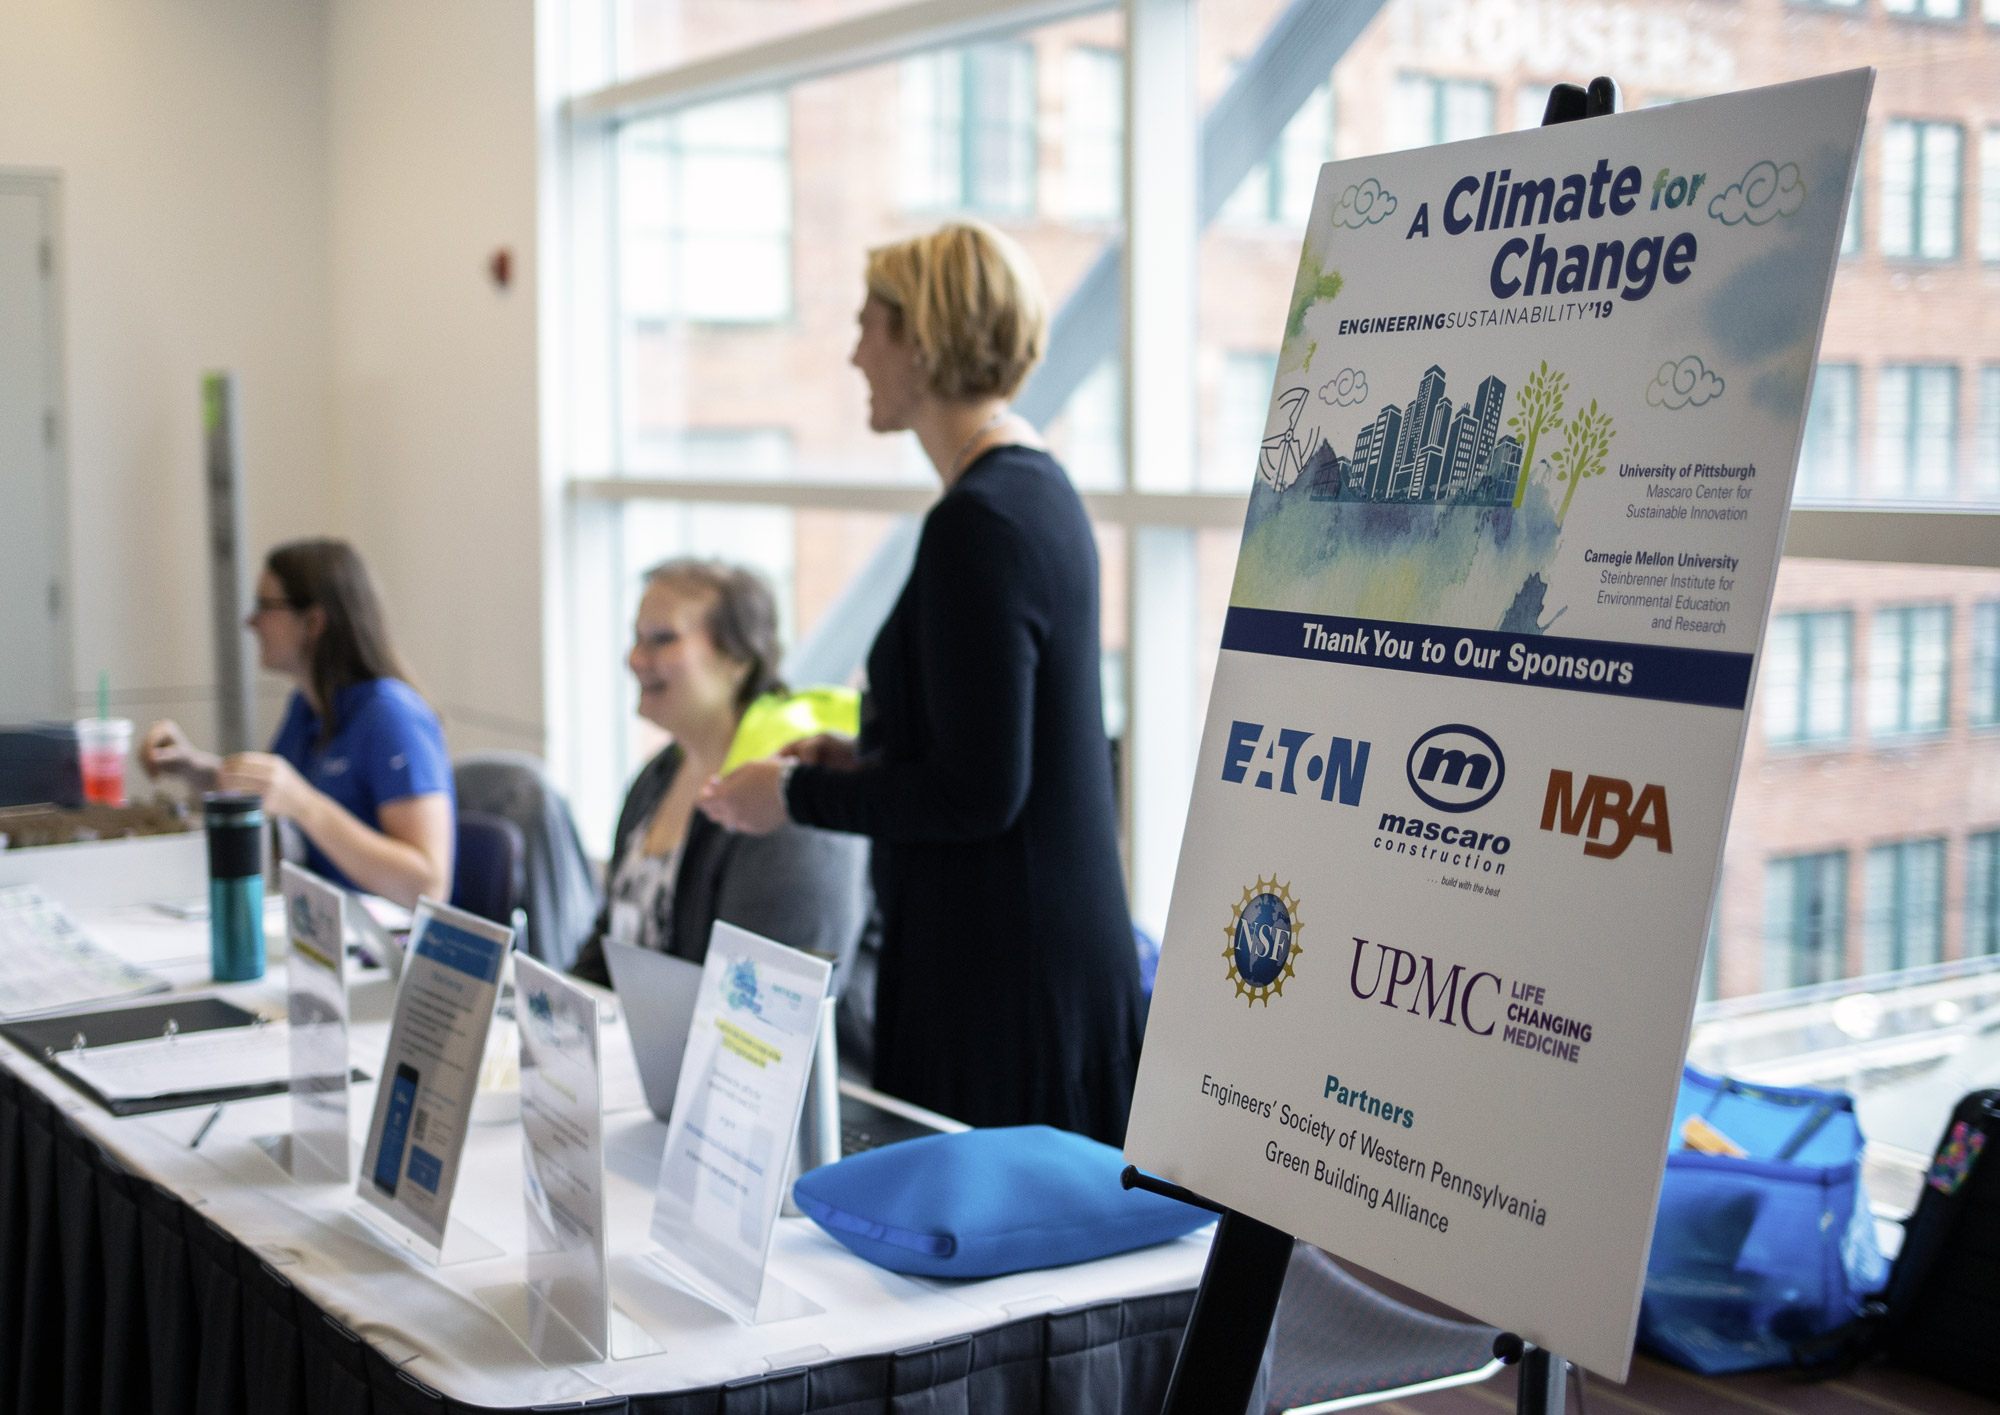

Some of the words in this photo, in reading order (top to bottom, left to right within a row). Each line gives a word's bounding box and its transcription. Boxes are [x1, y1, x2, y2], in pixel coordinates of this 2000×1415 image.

[1406, 202, 1429, 240] A
[1443, 158, 1642, 236] Climate
[1650, 167, 1706, 212] for
[1491, 231, 1698, 301] Change
[1619, 464, 1677, 480] University
[1679, 464, 1692, 478] of
[1694, 464, 1756, 481] Pittsburgh
[1646, 484, 1692, 499] Mascaro
[1696, 485, 1734, 499] Center
[1736, 486, 1752, 499] for
[1626, 504, 1687, 519] Sustainable
[1690, 505, 1748, 520] Innovation
[1584, 549, 1632, 566] Carnegie
[1635, 551, 1674, 566] Mellon
[1677, 553, 1739, 572] University
[1600, 570, 1668, 587] Steinbrenner
[1670, 574, 1715, 590] Institute
[1719, 576, 1735, 590] for
[1597, 590, 1673, 608] Environmental
[1675, 595, 1730, 612] Education
[1651, 616, 1672, 630] and
[1674, 616, 1726, 634] Research
[1301, 622, 1369, 657] Thank
[1372, 627, 1413, 661] You
[1421, 637, 1446, 664] to
[1453, 637, 1501, 670] Our
[1507, 644, 1634, 685] Sponsors
[1221, 720, 1371, 807] EATON
[1539, 768, 1673, 860] MBA
[1379, 813, 1511, 856] mascaro
[1373, 836, 1505, 875] construction
[1441, 876, 1458, 888] build
[1458, 881, 1472, 891] with
[1473, 883, 1484, 894] the
[1485, 885, 1501, 897] best
[1235, 917, 1291, 964] NSF
[1350, 937, 1503, 1036] UPMC
[1510, 980, 1546, 1006] LIFE
[1507, 1003, 1593, 1043] CHANGING
[1503, 1024, 1580, 1064] MEDICINE
[1323, 1074, 1415, 1129] Partners
[1279, 1104, 1335, 1146] Society
[1339, 1131, 1357, 1151] of
[1360, 1133, 1426, 1179] Western
[1430, 1161, 1548, 1227] Pennsylvania
[1265, 1140, 1310, 1176] Green
[1314, 1159, 1379, 1208] Building
[1382, 1188, 1449, 1234] Alliance
